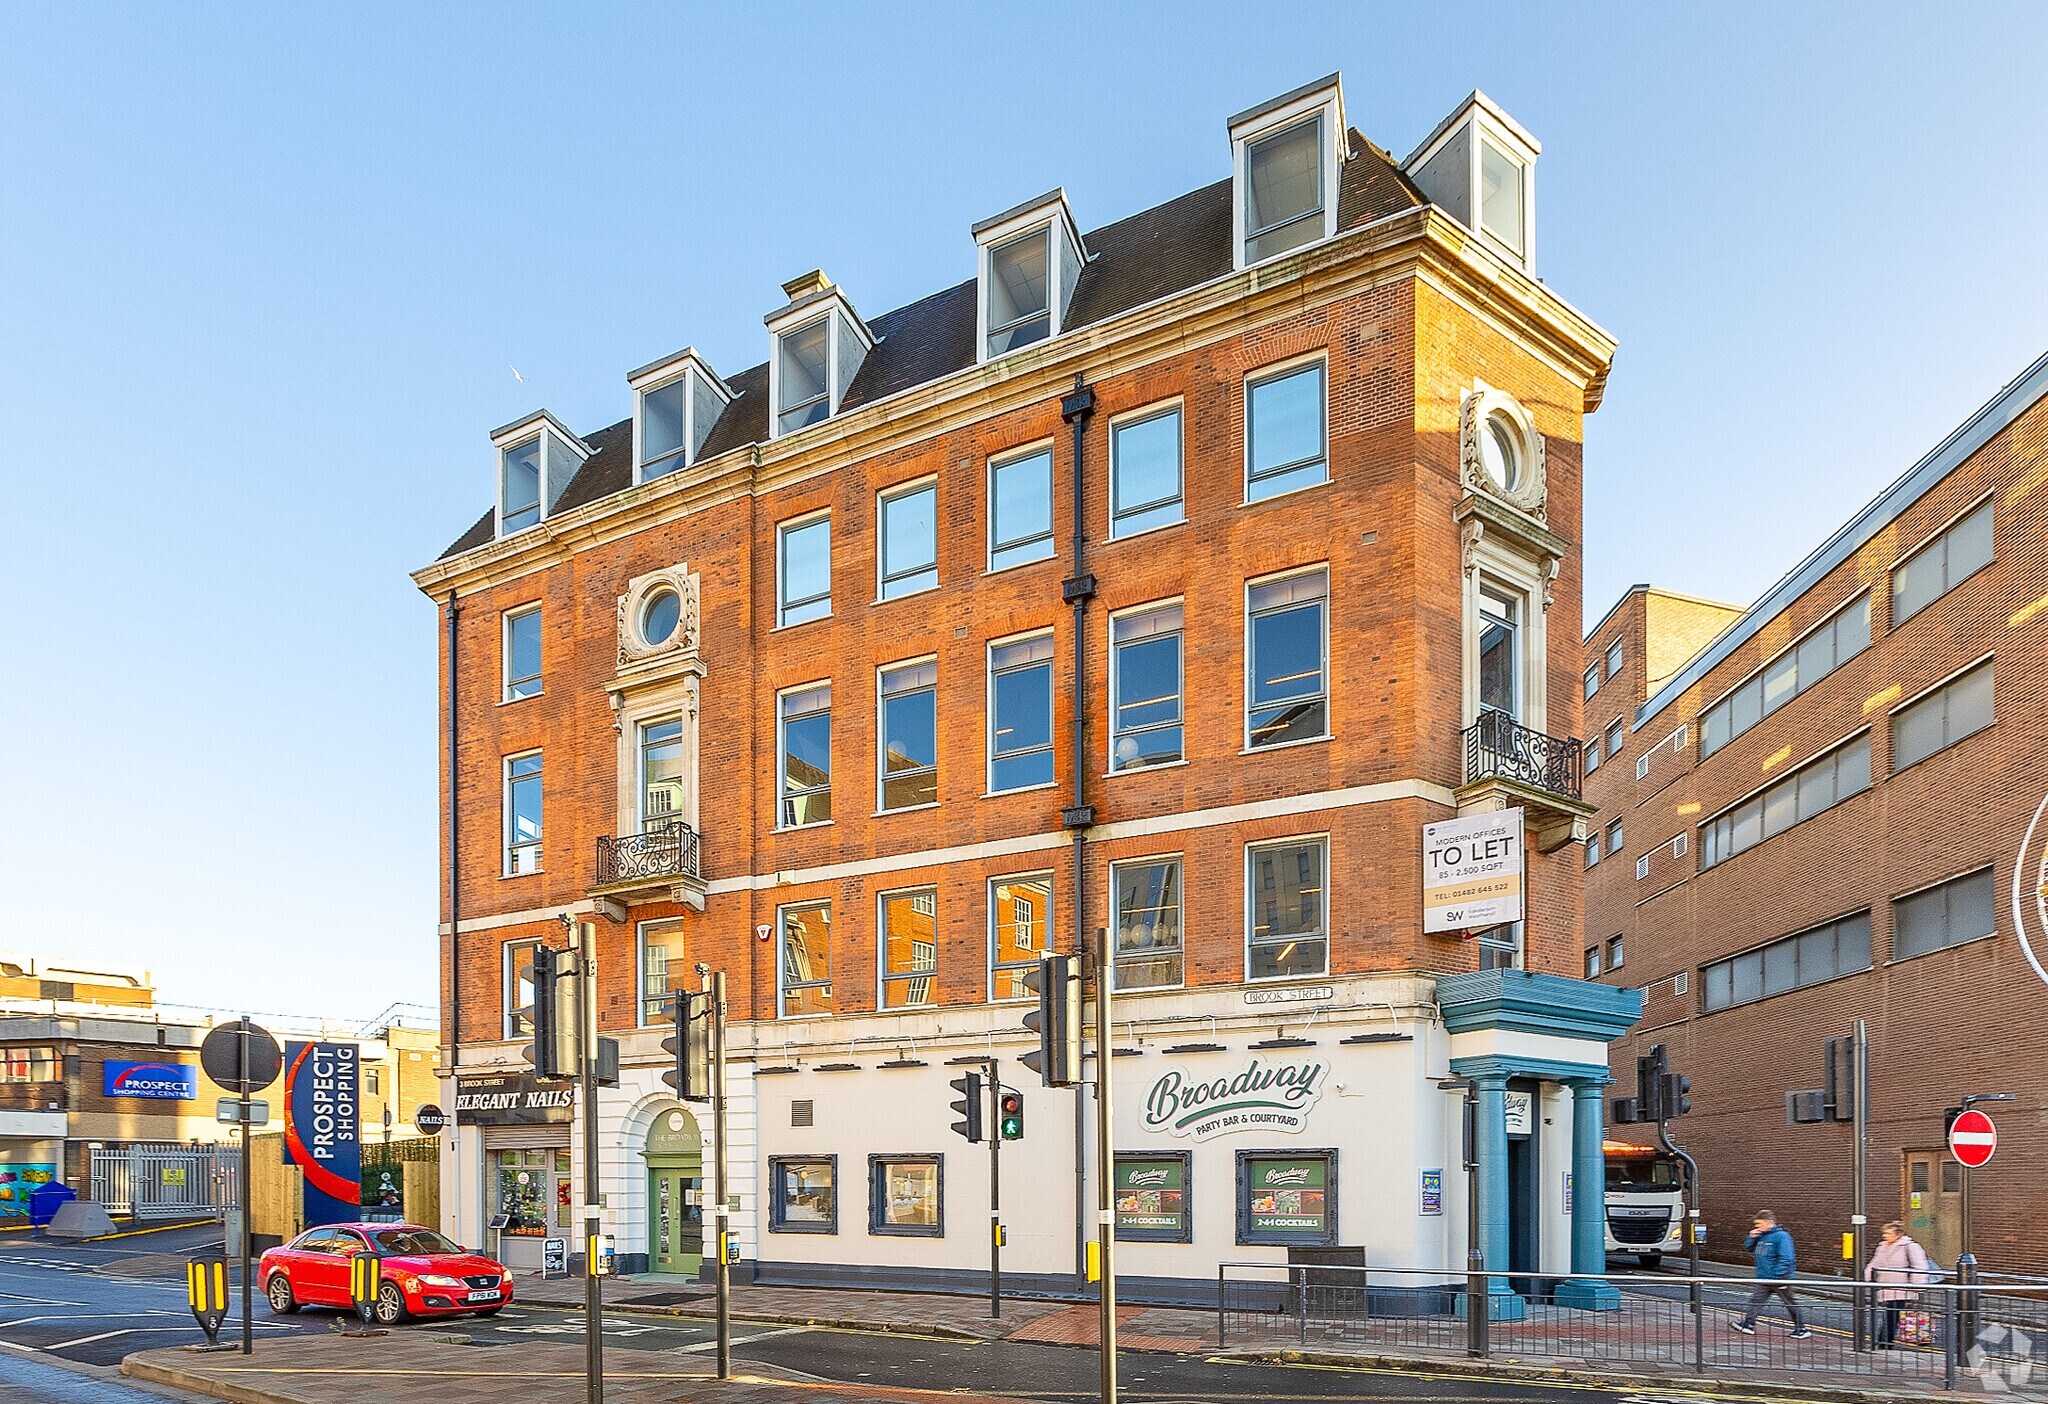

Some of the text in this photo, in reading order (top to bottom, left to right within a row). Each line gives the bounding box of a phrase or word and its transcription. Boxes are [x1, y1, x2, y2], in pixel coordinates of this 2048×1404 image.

[1435, 827, 1507, 847] MODERN OFFICES
[1428, 836, 1514, 868] TO LET
[1480, 861, 1504, 872] SQFT
[1434, 882, 1509, 901] TEL: 01482 645 522
[1249, 988, 1328, 1002] BROOK STREET
[124, 1079, 190, 1092] PROSPECT
[464, 1079, 483, 1088] BROOK
[483, 1078, 505, 1087] STREET
[112, 1088, 156, 1097] SHOPPING
[337, 1047, 354, 1141] SHOPPING
[455, 1089, 573, 1111] ELEGANT NAILS
[1146, 1059, 1322, 1126] Broadway
[312, 1046, 334, 1159] PROSPECT
[419, 1115, 443, 1125] NAILS
[1195, 1112, 1299, 1136] PARTY BAR & COURTYARD
[1265, 1167, 1310, 1184] Broadway
[1137, 1216, 1177, 1226] COCKTAILS
[1274, 1218, 1319, 1228] COCKTAILS
